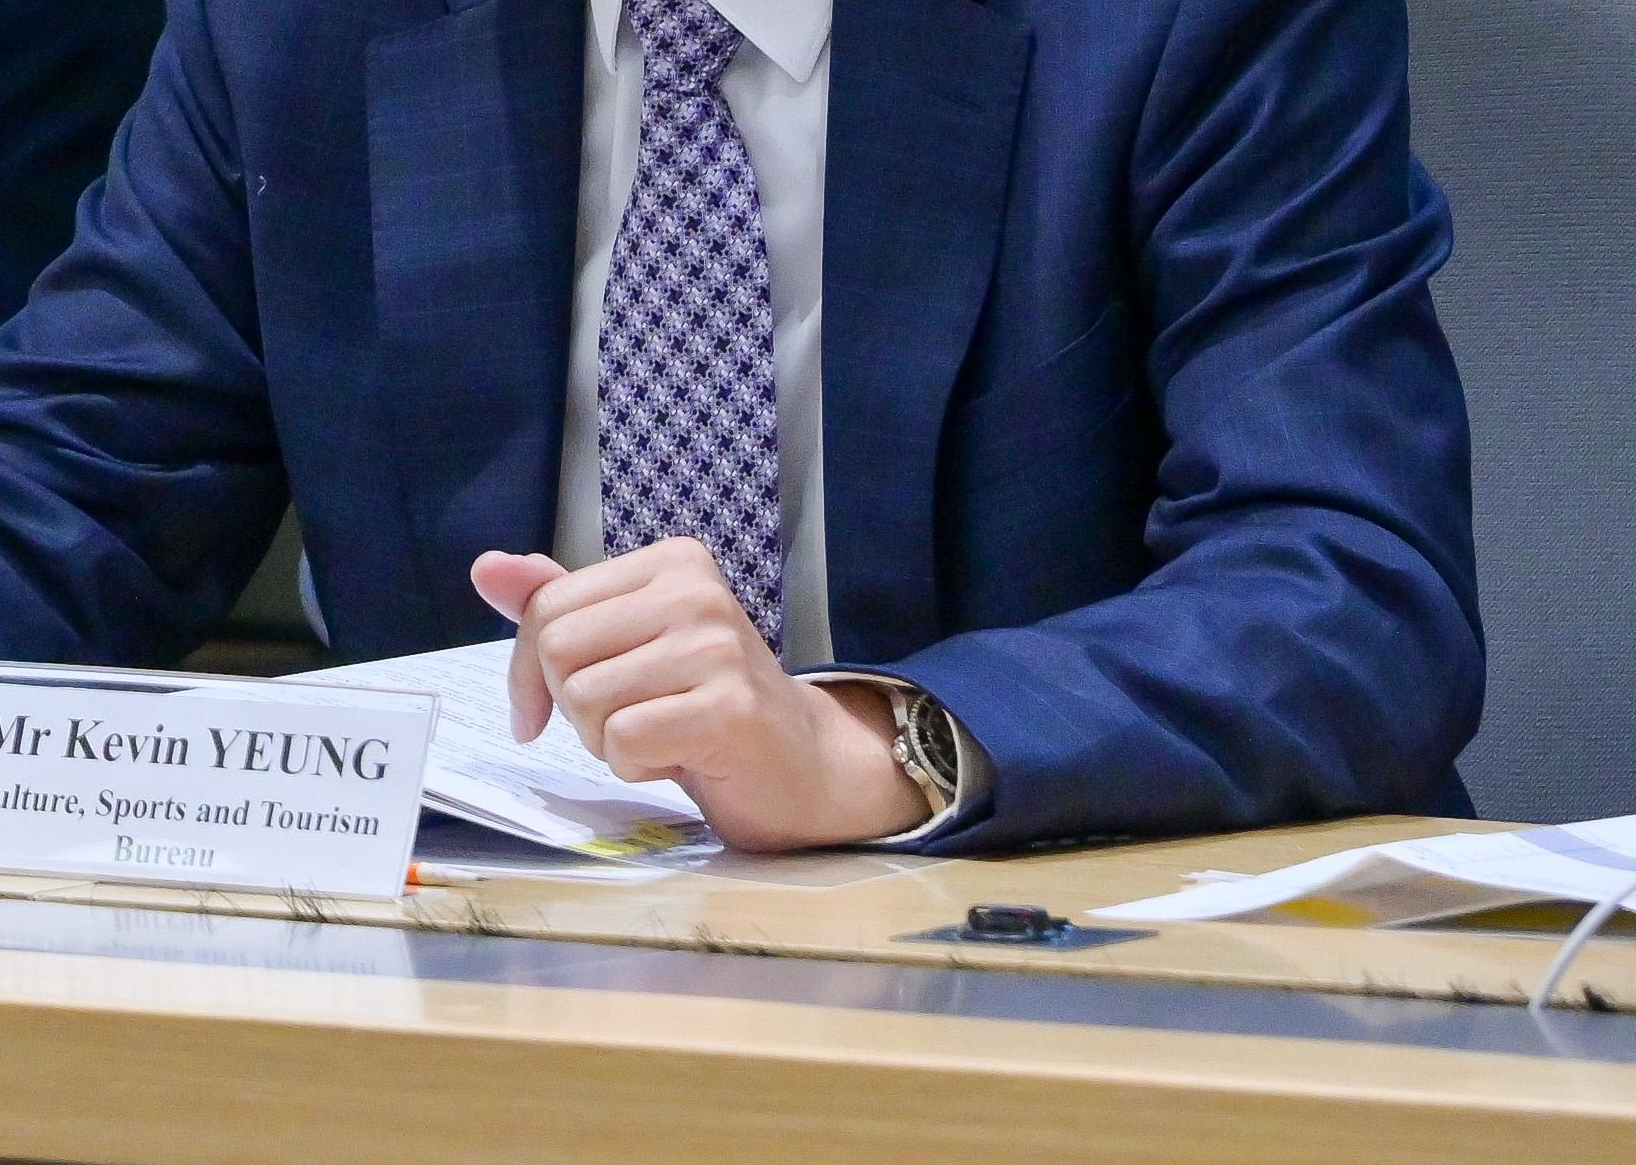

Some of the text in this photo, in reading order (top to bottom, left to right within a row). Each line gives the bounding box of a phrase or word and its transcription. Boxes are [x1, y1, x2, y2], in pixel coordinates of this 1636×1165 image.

[61, 717, 189, 766] Kevin
[207, 726, 390, 780] YEUNG
[95, 787, 187, 825] Sports
[195, 800, 251, 826] and
[260, 800, 380, 836] Tourism
[114, 834, 215, 868] Bureau
